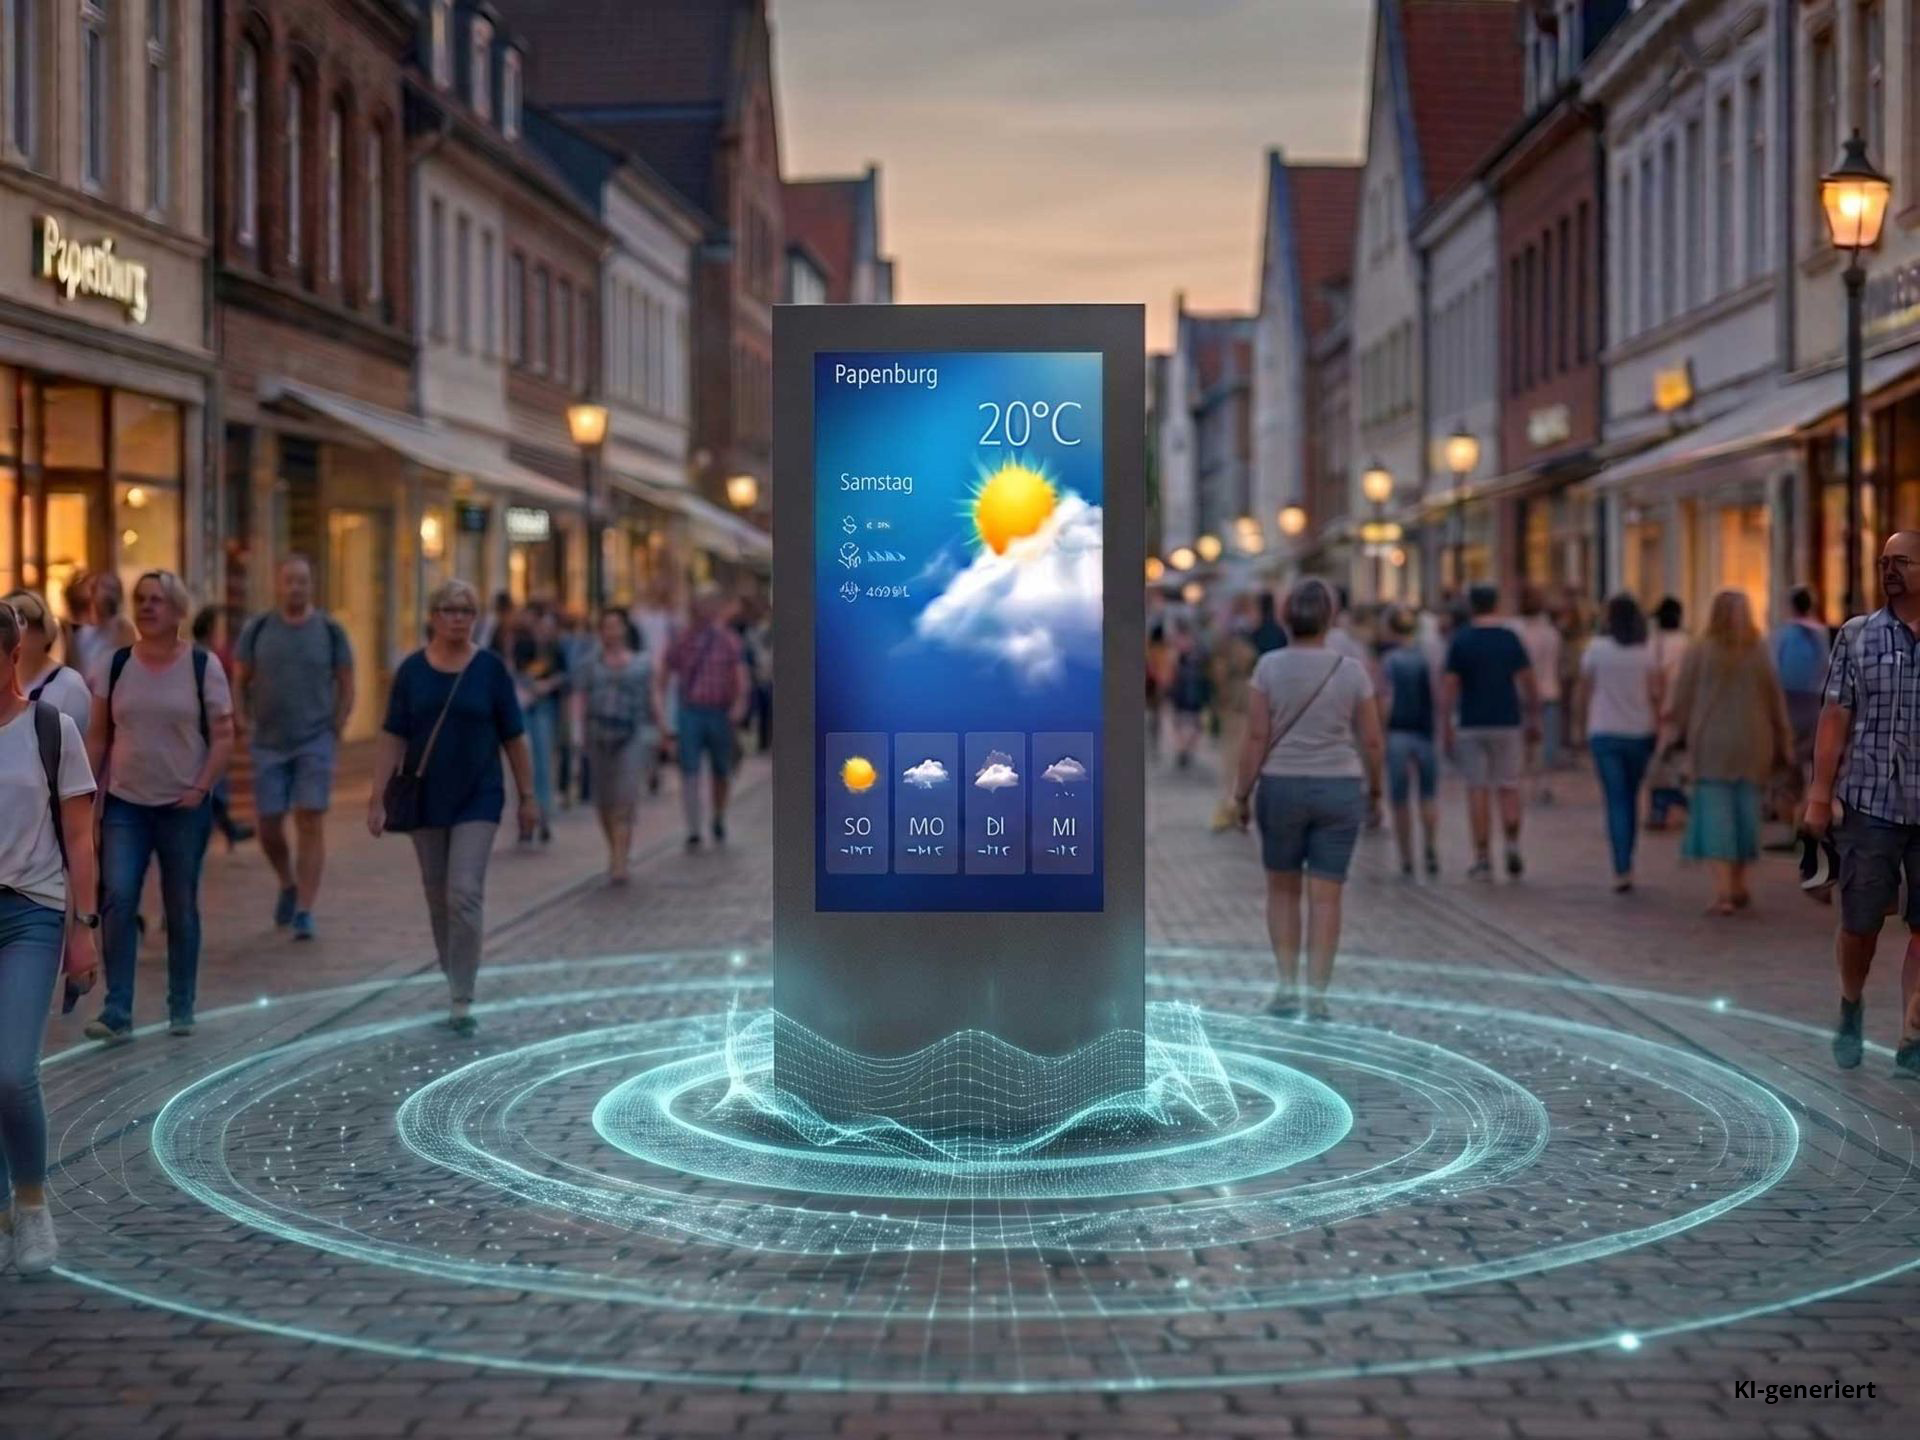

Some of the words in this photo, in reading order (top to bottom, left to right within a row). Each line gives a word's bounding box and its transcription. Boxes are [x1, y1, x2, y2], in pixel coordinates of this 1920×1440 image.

[835, 363, 938, 389] Papenburg
[978, 400, 1082, 447] 20°C
[840, 472, 913, 494] Samstag
[844, 817, 871, 836] SO
[909, 816, 944, 836] MO
[986, 816, 1005, 836] DI
[1052, 816, 1076, 837] MI
